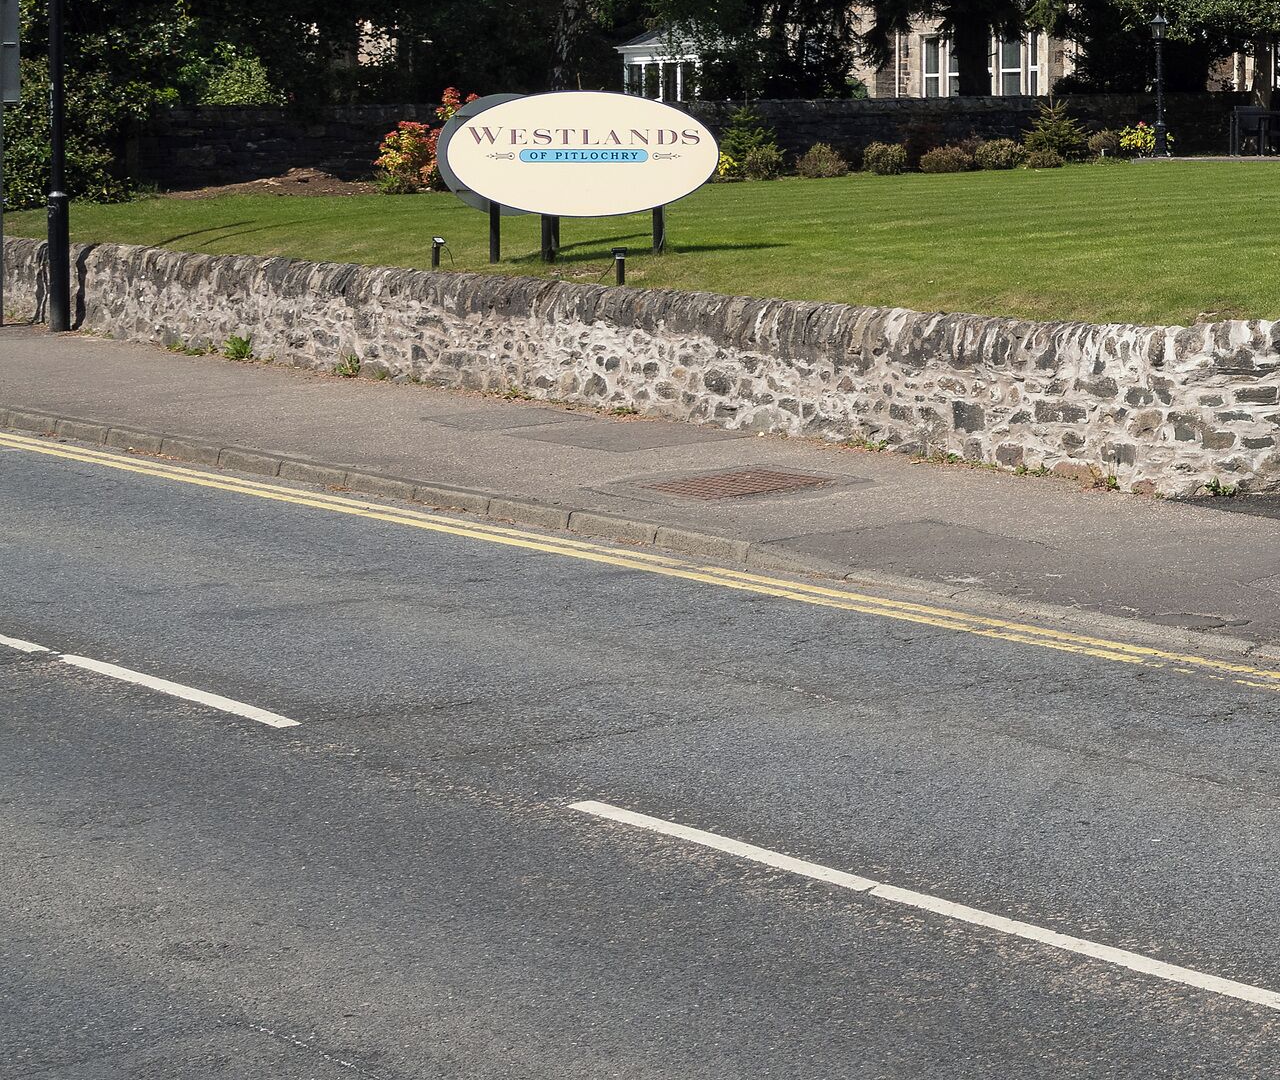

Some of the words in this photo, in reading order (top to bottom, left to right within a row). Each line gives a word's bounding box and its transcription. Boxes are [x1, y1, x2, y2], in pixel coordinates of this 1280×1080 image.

[467, 126, 701, 145] WESTLANDS
[529, 151, 548, 160] OF
[555, 151, 639, 160] PITLOCHRY
